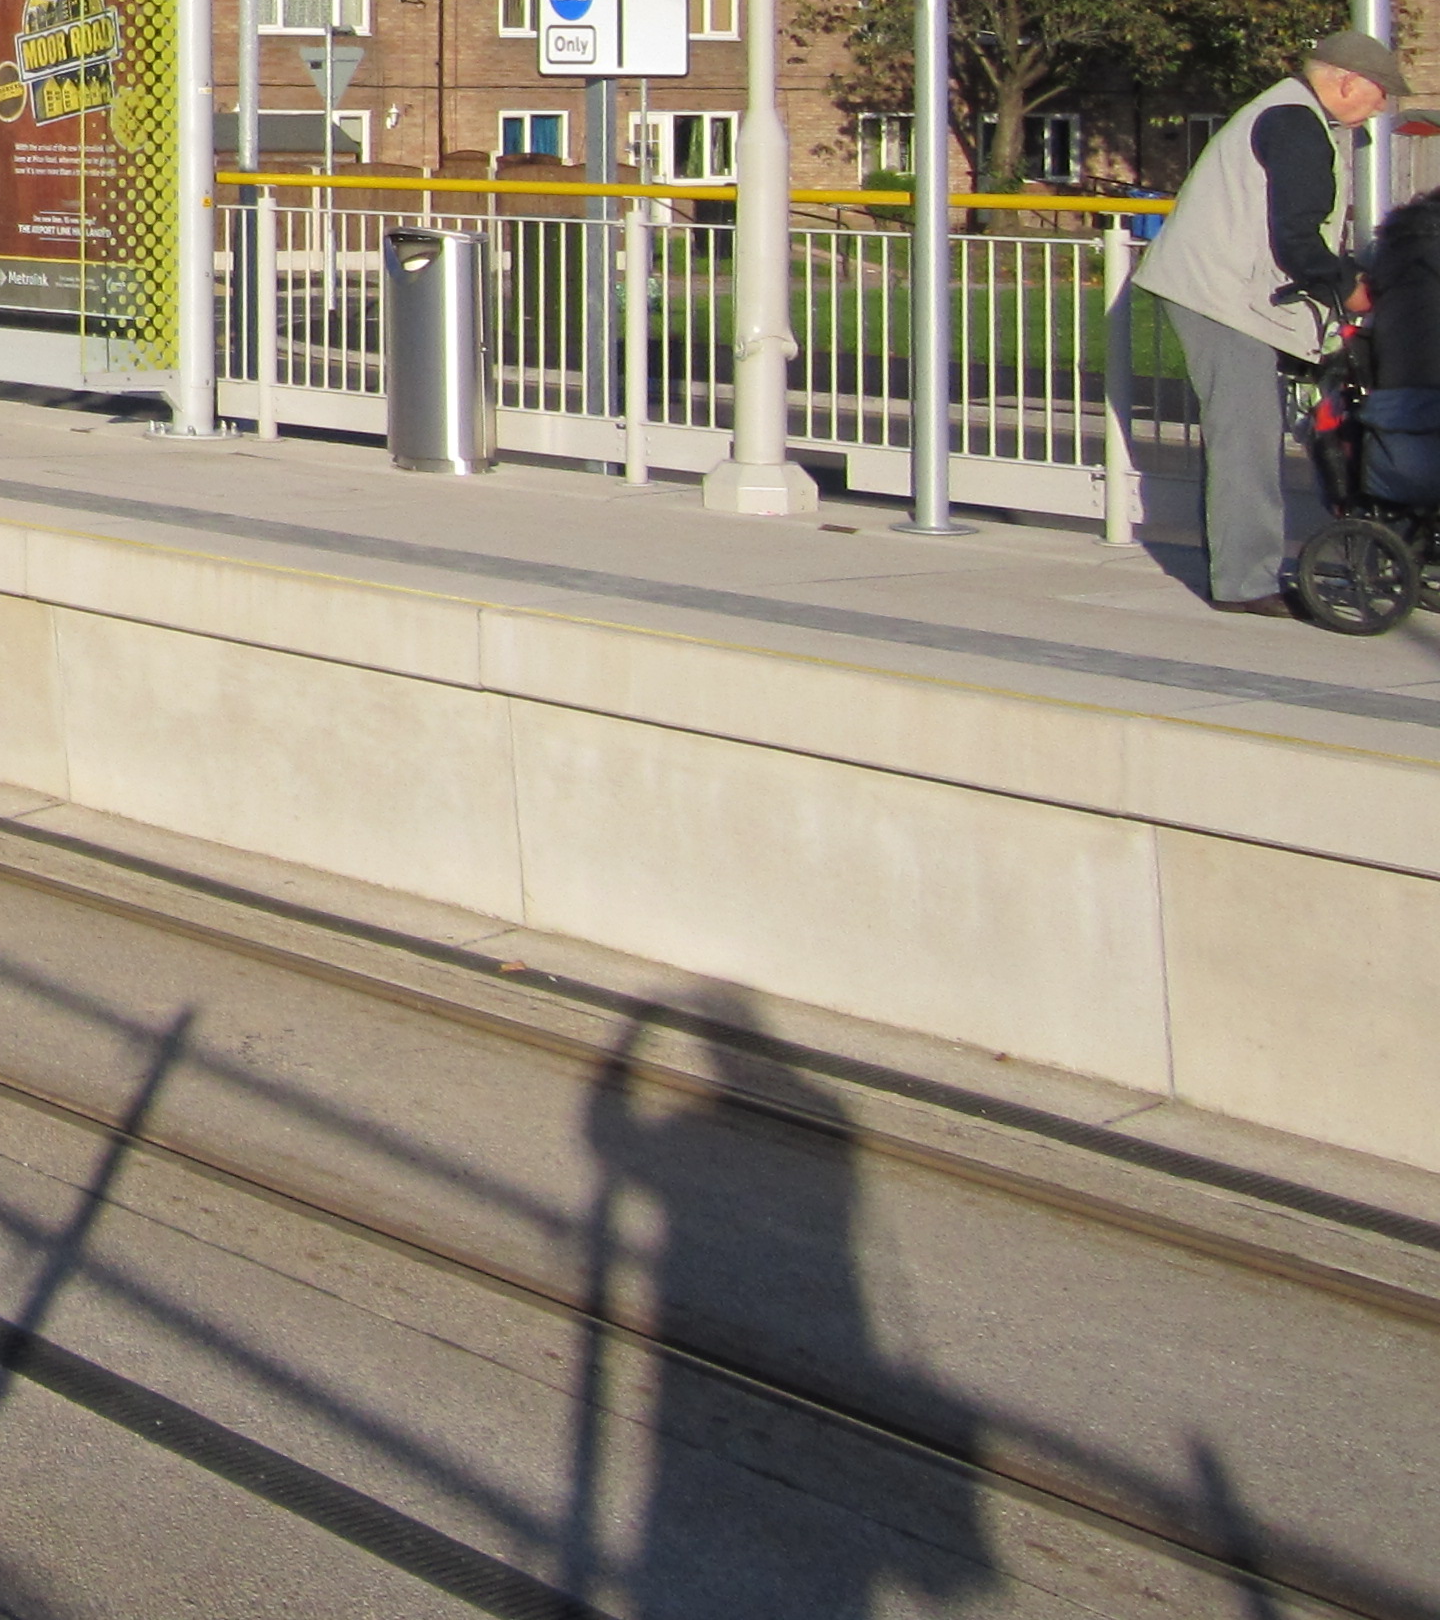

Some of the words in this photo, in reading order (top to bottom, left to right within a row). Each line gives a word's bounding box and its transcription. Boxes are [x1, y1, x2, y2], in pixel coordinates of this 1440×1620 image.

[24, 32, 68, 70] MOOR
[70, 17, 116, 57] ROAD
[554, 36, 588, 55] Only
[18, 224, 31, 233] THE
[31, 225, 55, 235] AIRPORT
[57, 225, 71, 236] LINE
[8, 270, 49, 287] Metrolink
